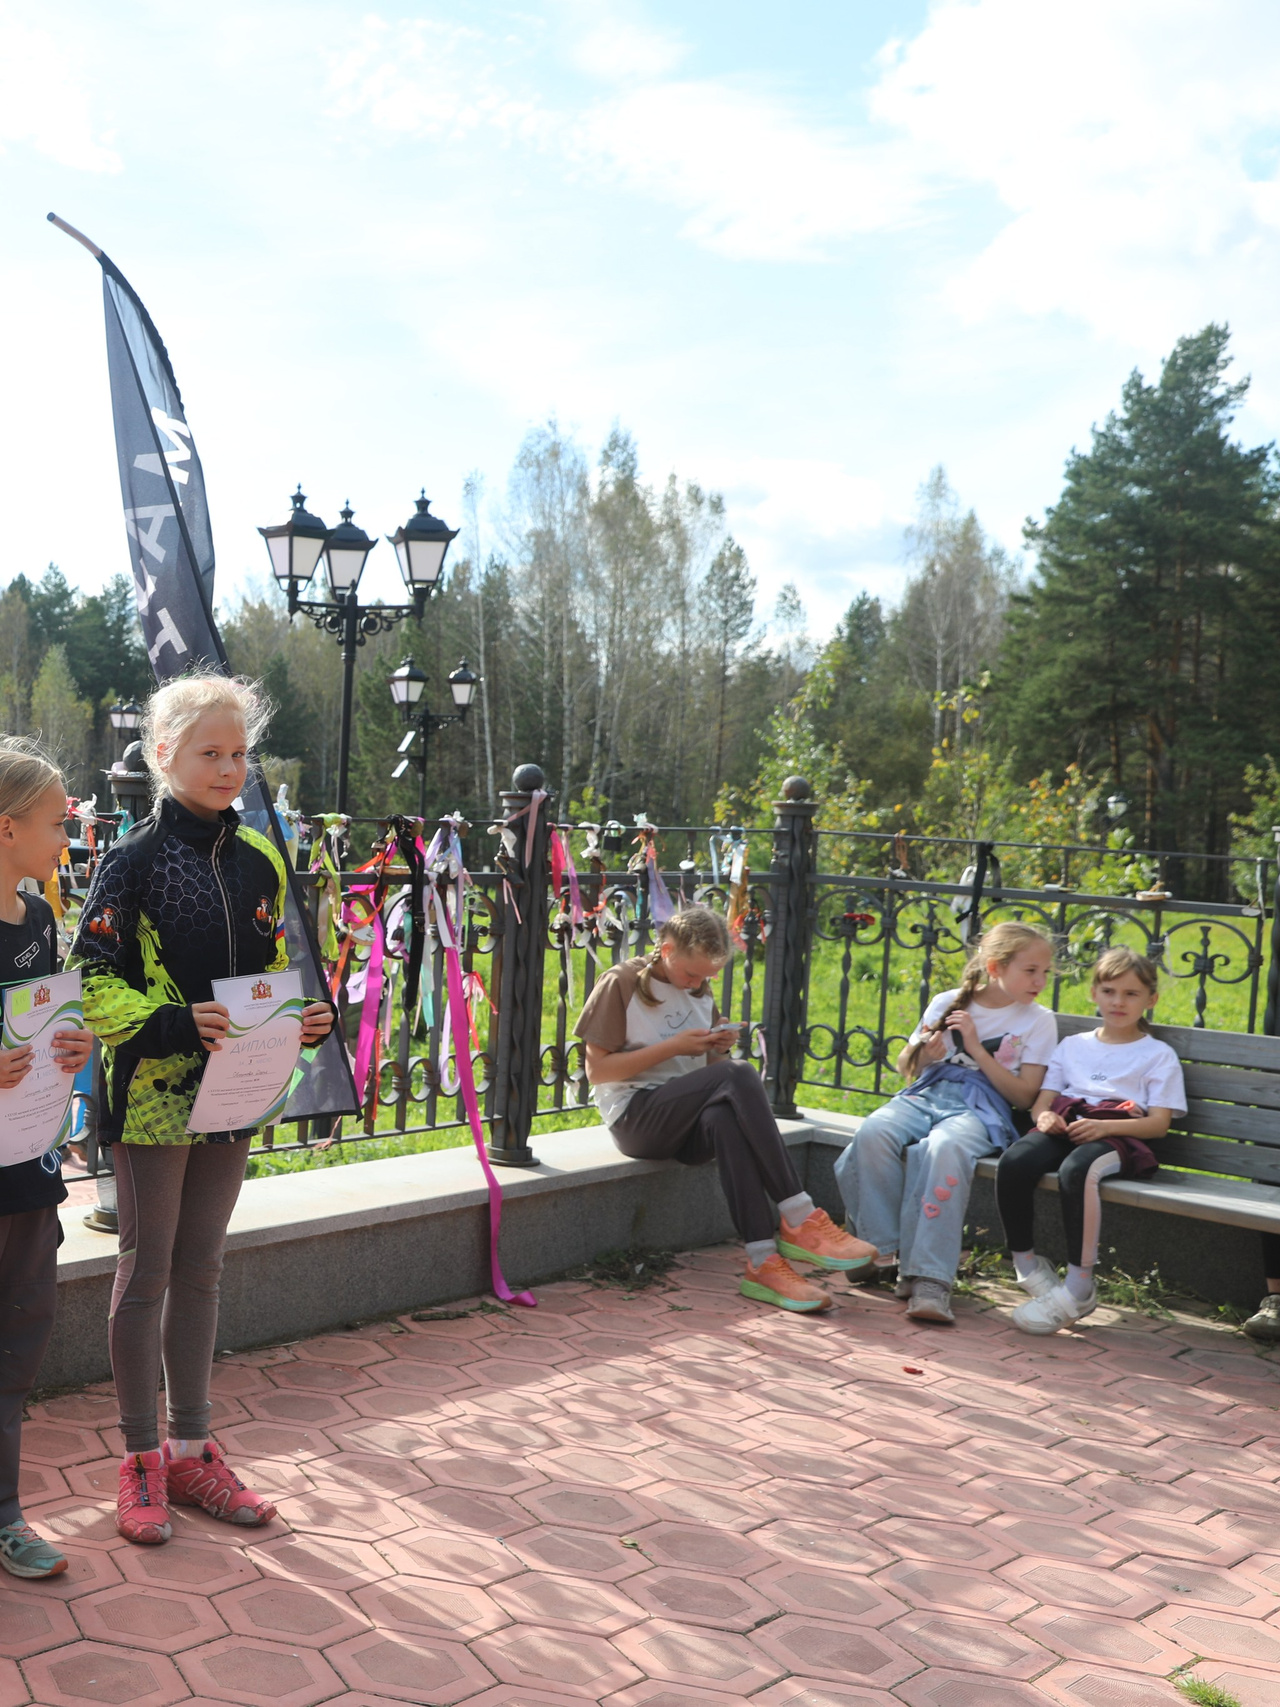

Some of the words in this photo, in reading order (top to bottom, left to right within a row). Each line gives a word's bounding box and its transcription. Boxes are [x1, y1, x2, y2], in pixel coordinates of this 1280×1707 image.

[19, 951, 33, 964] LEVEL
[230, 1036, 287, 1055] ДИПЛОМ
[1090, 1072, 1107, 1081] alo
